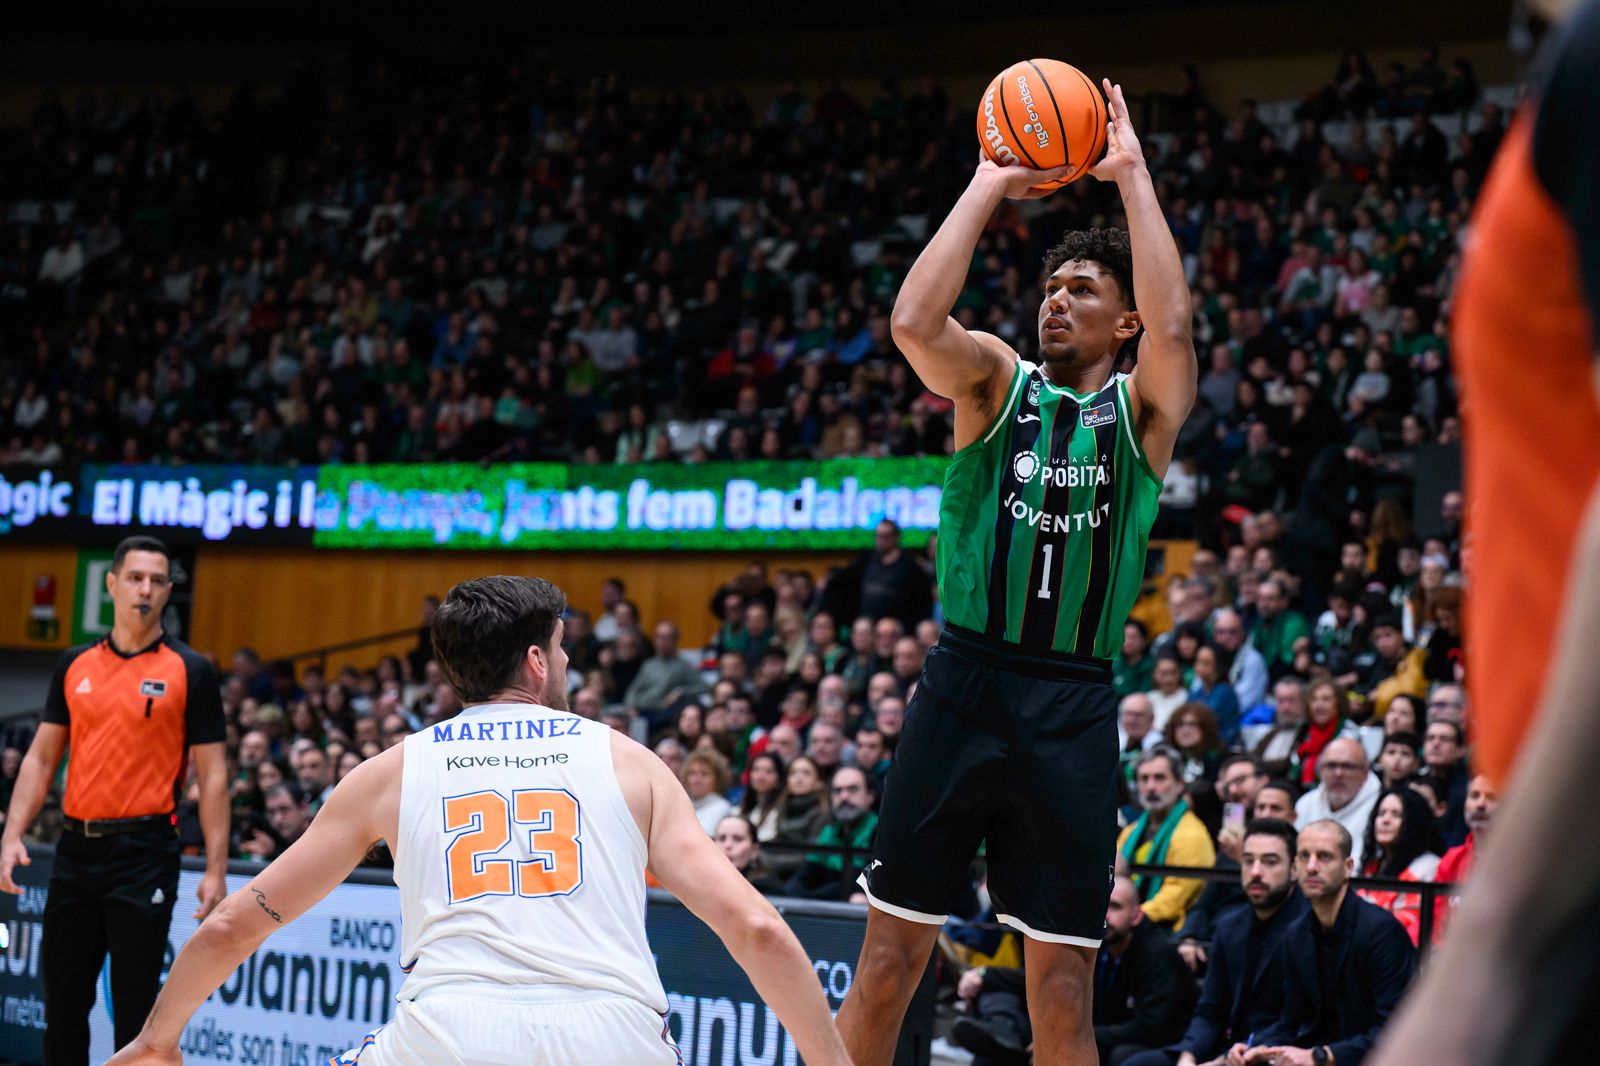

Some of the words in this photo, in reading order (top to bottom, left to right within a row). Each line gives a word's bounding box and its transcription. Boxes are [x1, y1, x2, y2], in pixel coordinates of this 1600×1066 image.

[1033, 122, 1049, 148] liga
[1040, 465, 1111, 488] POBITAS
[92, 478, 135, 526] El
[139, 477, 269, 541] Màgic
[273, 479, 293, 528] i
[626, 478, 717, 530] fem
[723, 476, 943, 530] Badalona
[1004, 491, 1110, 533] JOVENTUT
[1037, 543, 1054, 599] 1
[432, 717, 582, 743] MARTINEZ
[446, 755, 501, 771] Kave
[504, 752, 569, 769] Home
[442, 787, 584, 906] 23
[330, 917, 397, 952] BANCO
[180, 1015, 234, 1062] uáles
